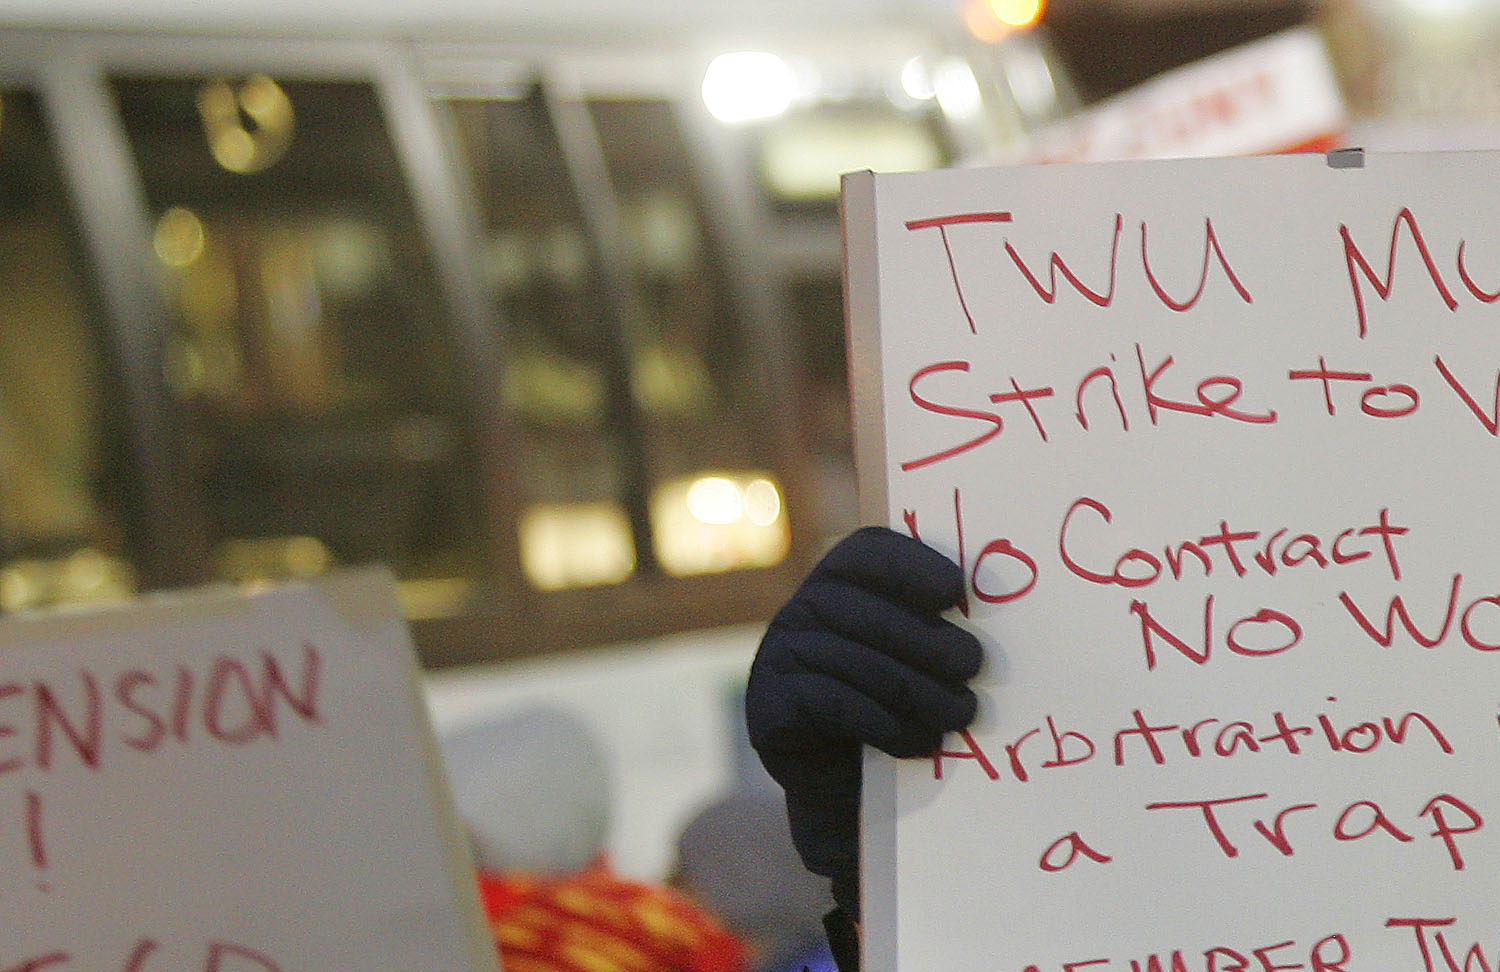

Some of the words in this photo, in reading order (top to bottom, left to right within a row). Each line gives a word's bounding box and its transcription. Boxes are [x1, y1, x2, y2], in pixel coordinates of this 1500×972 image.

[905, 212, 1253, 334] TWU
[900, 342, 1278, 472] Strike
[1288, 356, 1420, 419] to
[1058, 497, 1410, 588] Contract
[1038, 830, 1113, 873] a
